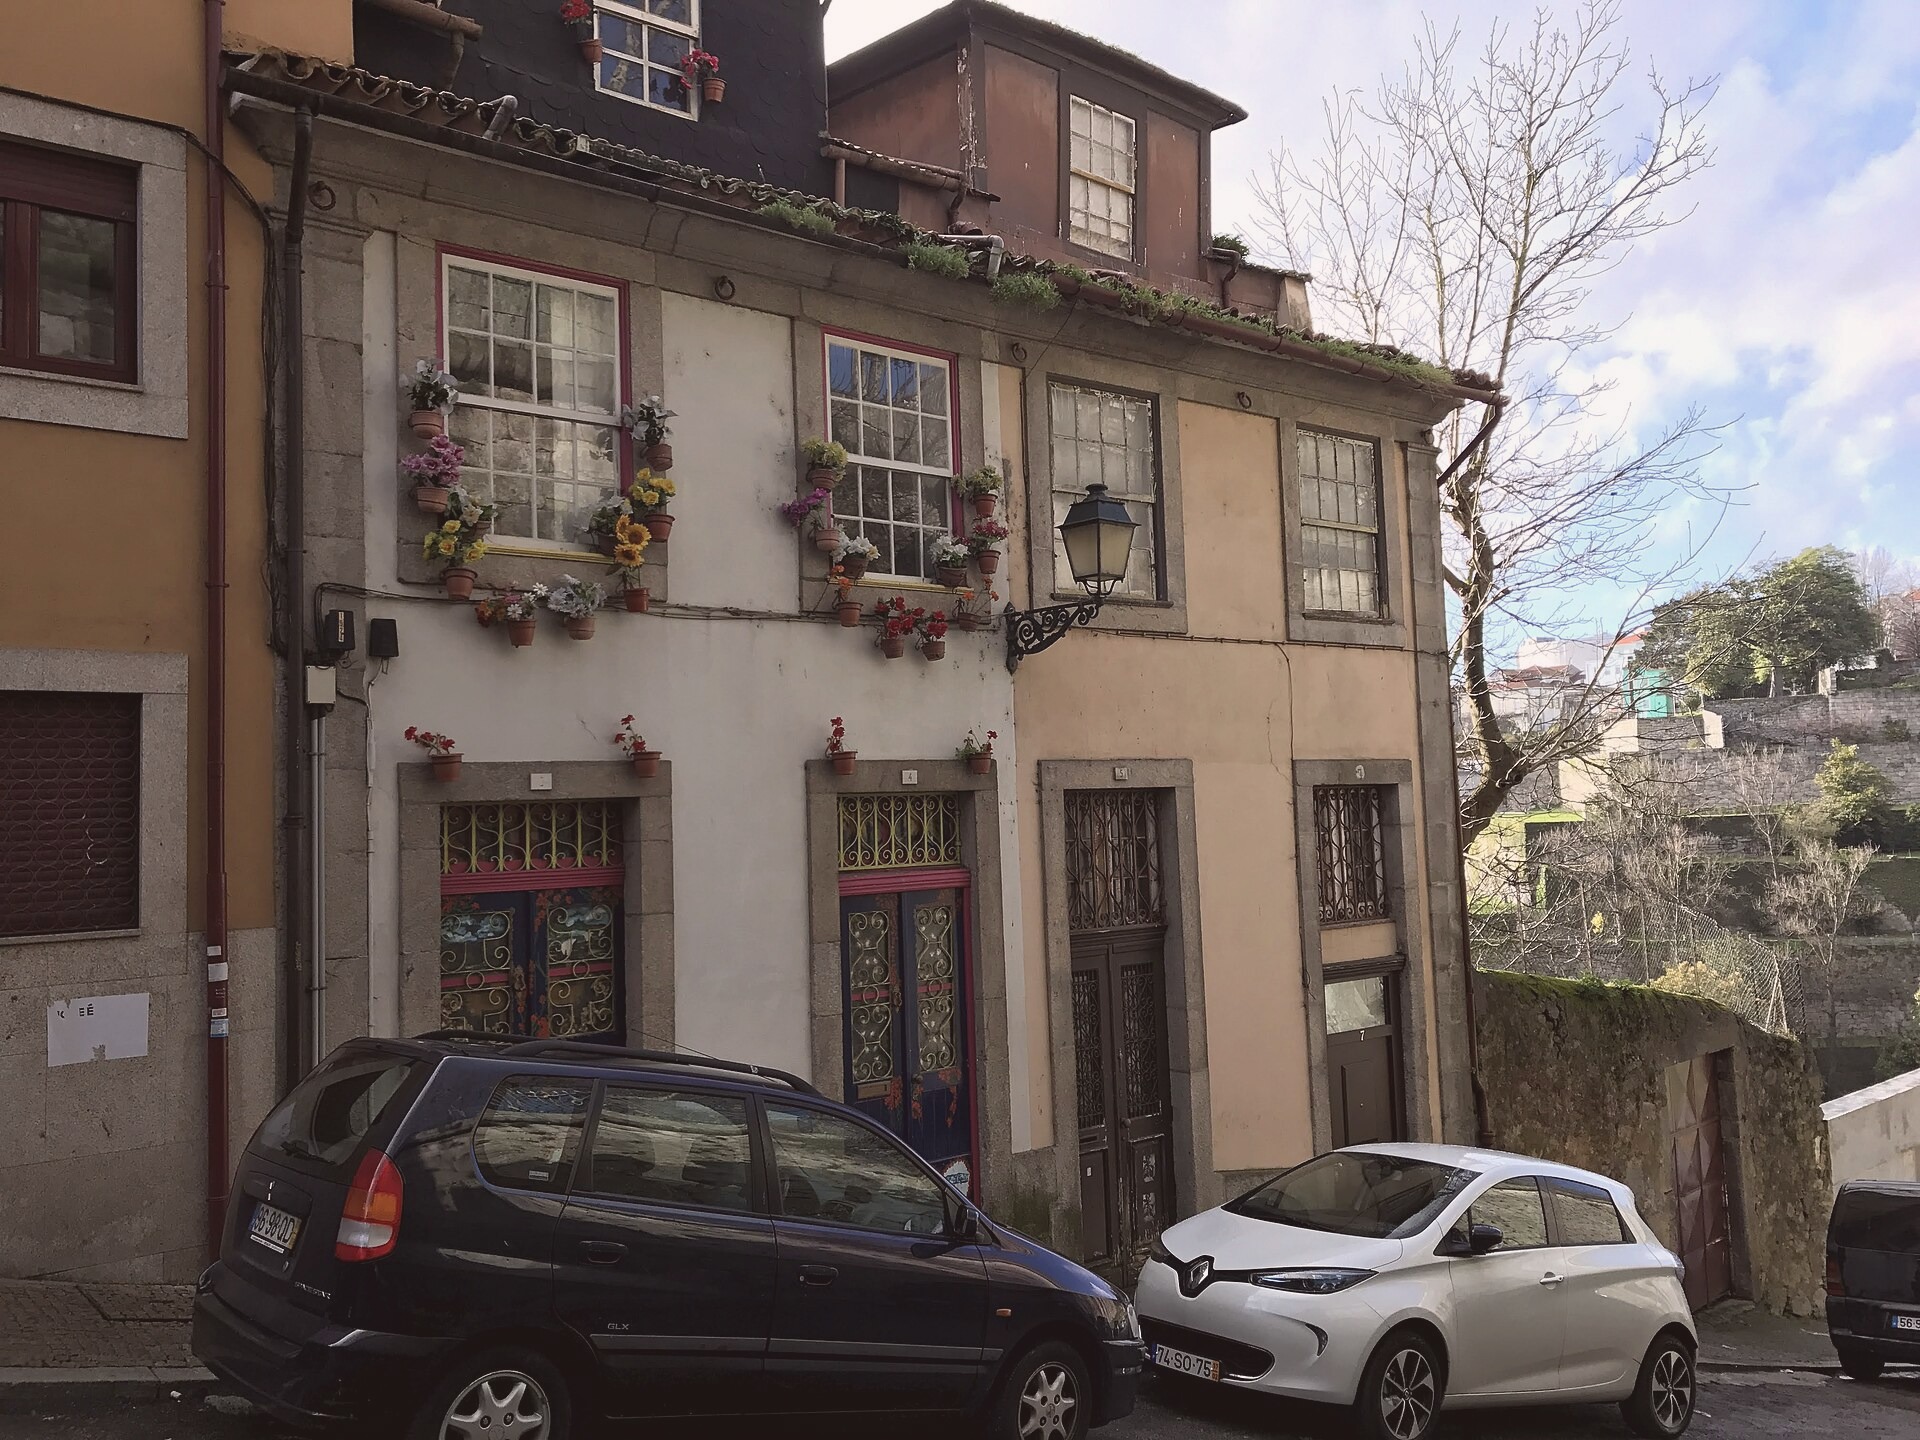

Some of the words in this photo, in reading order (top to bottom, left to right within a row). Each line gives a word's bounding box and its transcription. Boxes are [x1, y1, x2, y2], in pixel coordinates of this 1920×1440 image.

[1359, 1030, 1365, 1041] 7
[607, 1322, 630, 1330] GLX
[1157, 1346, 1212, 1378] 74-SO-75
